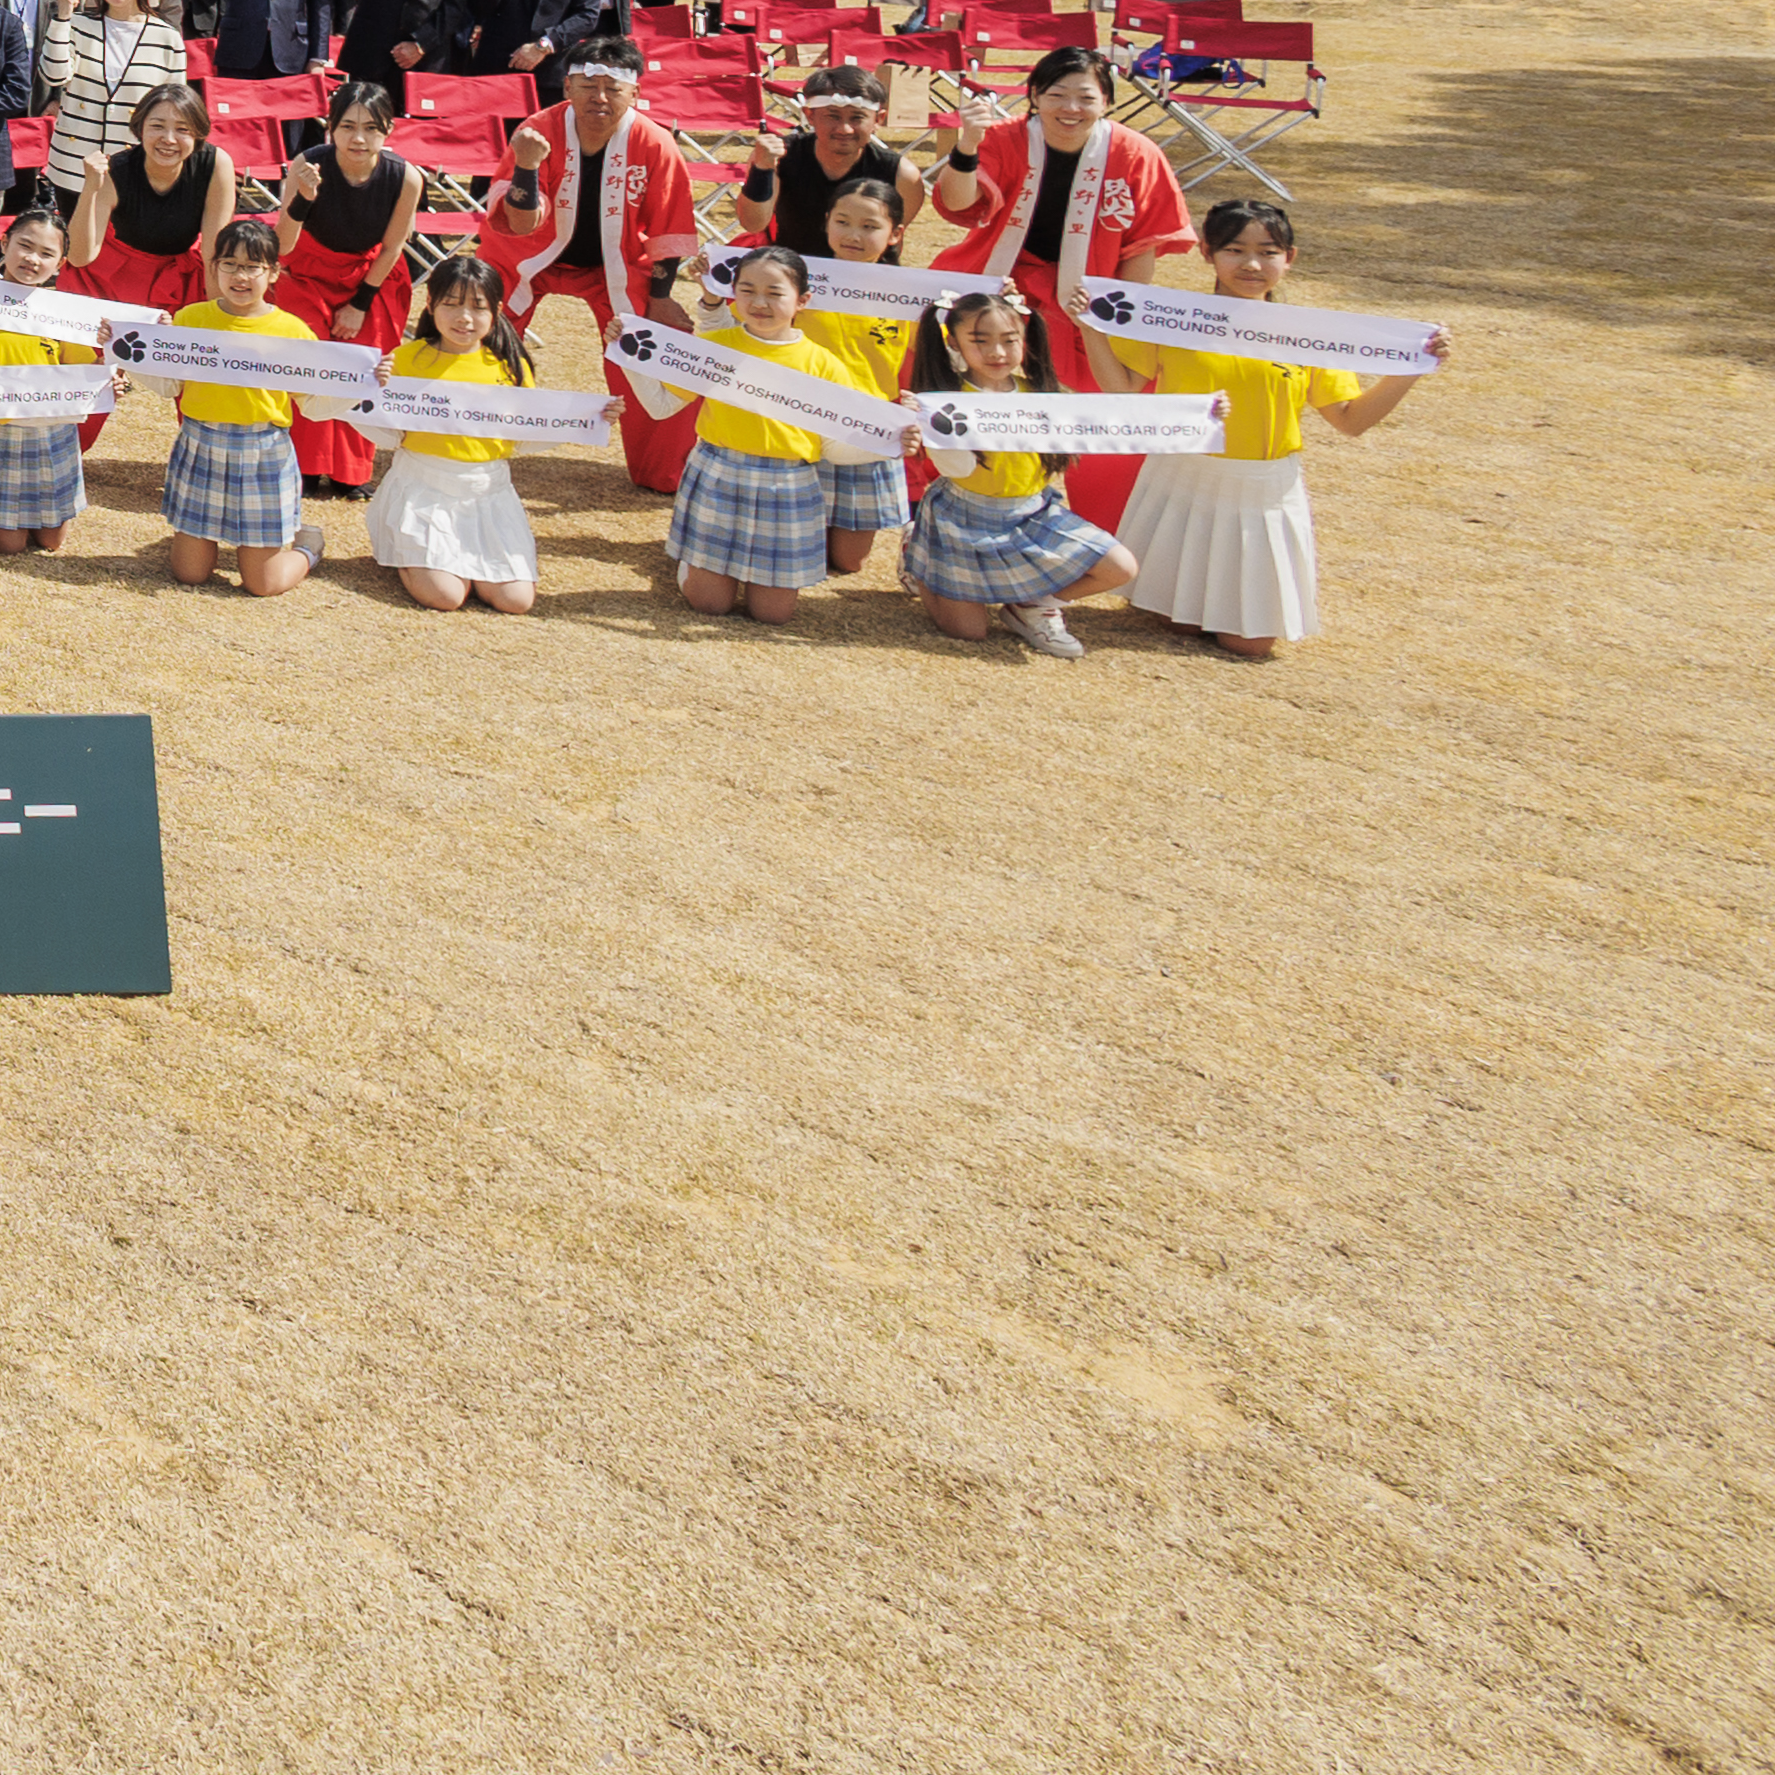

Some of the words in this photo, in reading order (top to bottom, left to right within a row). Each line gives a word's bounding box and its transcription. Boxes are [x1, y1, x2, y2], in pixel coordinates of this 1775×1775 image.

[807, 272, 831, 283] eak
[1, 294, 29, 308] Peak
[1143, 300, 1187, 317] Snow
[1193, 307, 1230, 324] Peak
[31, 312, 101, 333] YOSHINOGA
[153, 339, 186, 350] Snow
[190, 343, 219, 354] Peak
[1142, 314, 1227, 337] GROUNDS
[1233, 328, 1355, 355] YOSHINOGARI
[1360, 345, 1419, 363] OPEN!
[152, 352, 218, 368] GROUNDS
[222, 359, 316, 378] YOSHINOGARI
[319, 370, 364, 383] OPEN!
[665, 343, 700, 363] Snow
[704, 355, 737, 376] Peak
[62, 390, 99, 402] OPEN
[383, 389, 416, 401] Snow
[421, 393, 450, 405] Peak
[660, 355, 731, 387] GROUNDS
[736, 380, 838, 422] YOSHINOGARI
[841, 415, 892, 441] OPEN!
[382, 403, 450, 417] GROUNDS
[453, 409, 548, 427] YOSHINOGARI
[551, 419, 594, 431] OPEN!
[975, 409, 1012, 421] Snow
[1016, 409, 1049, 421] Peak
[977, 423, 1049, 435] GROUNDS
[1053, 424, 1156, 437] YOSHINOGARI
[1161, 424, 1208, 437] OPEN!
